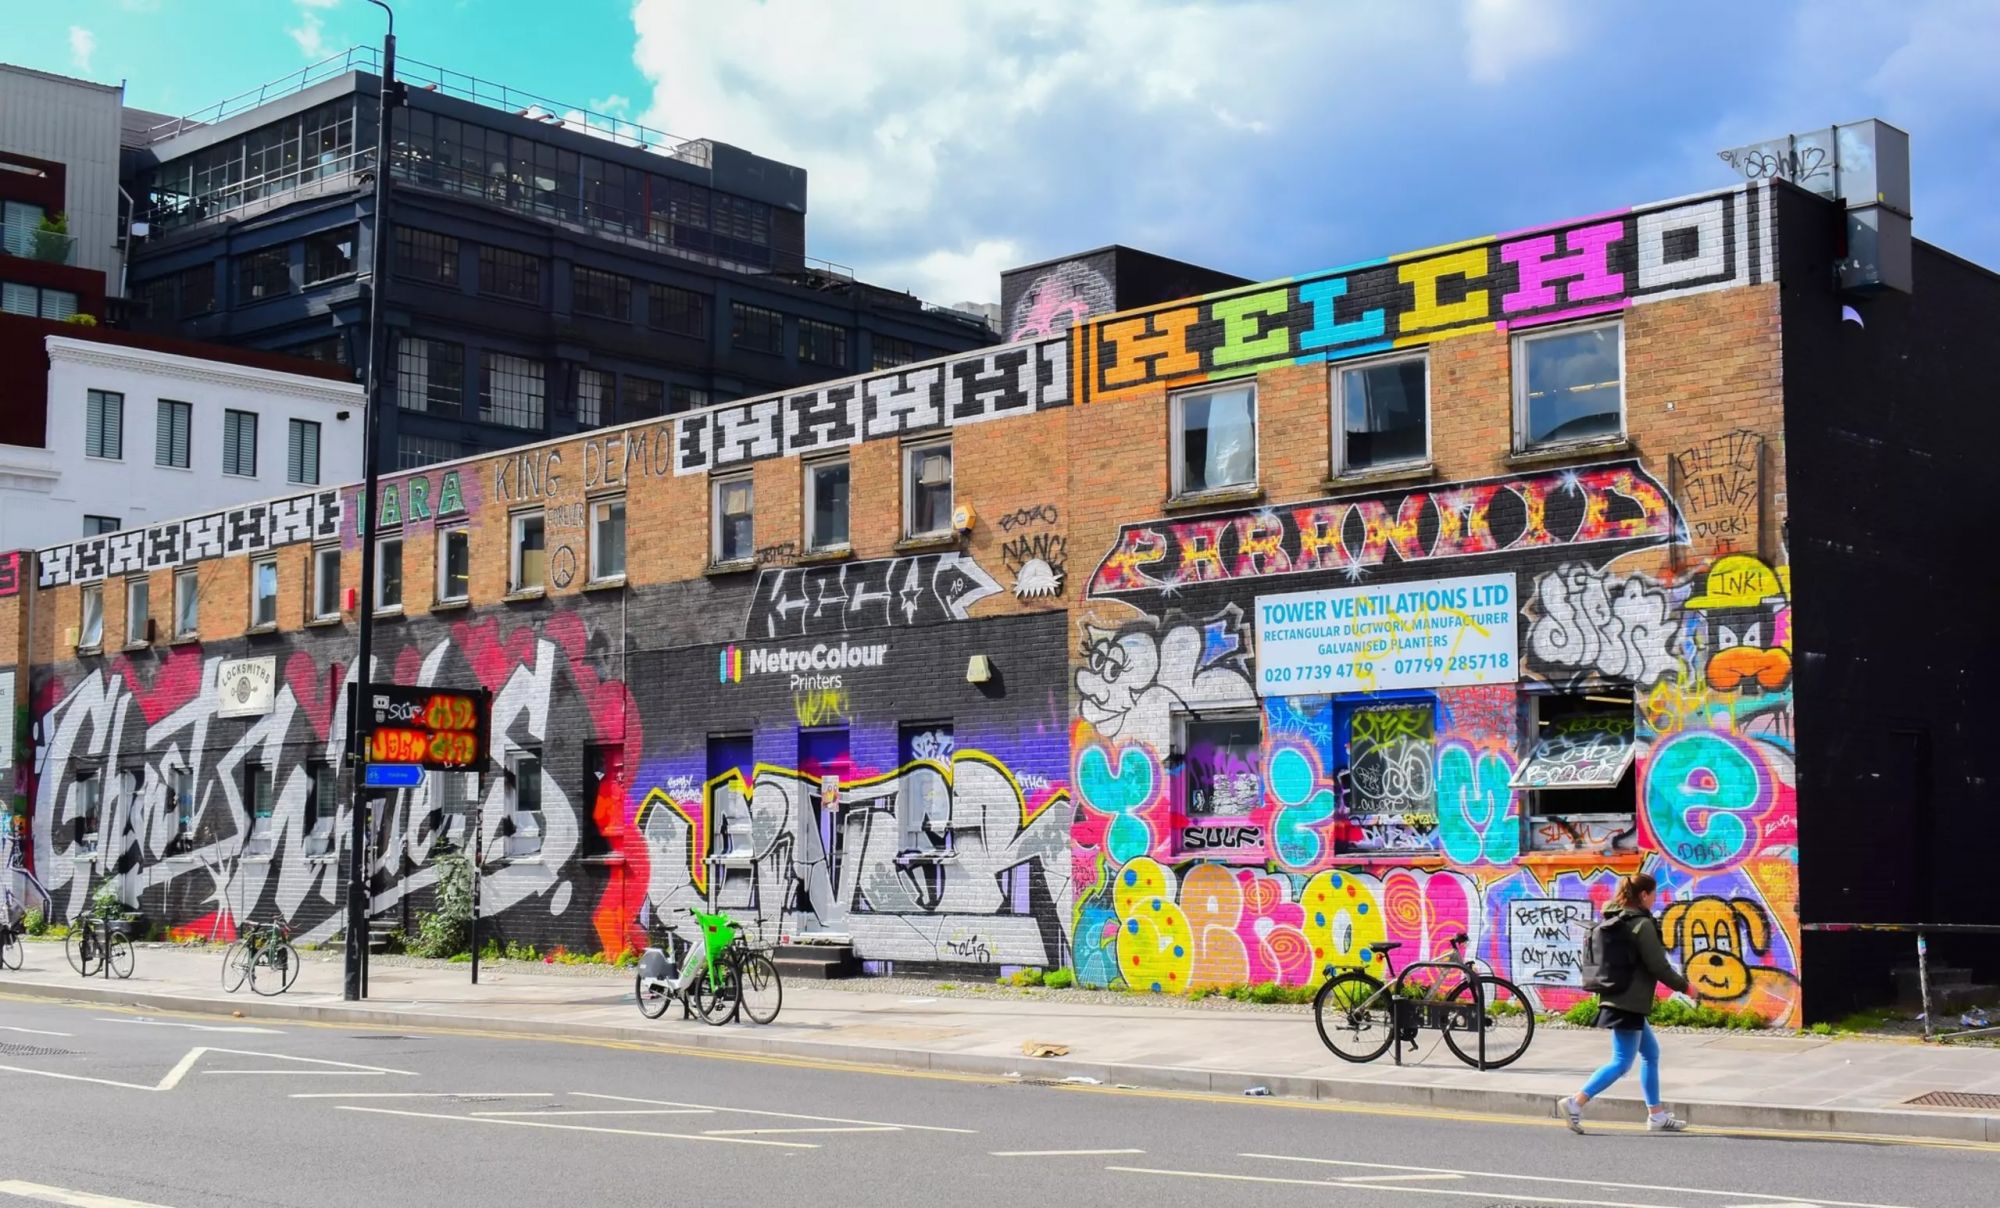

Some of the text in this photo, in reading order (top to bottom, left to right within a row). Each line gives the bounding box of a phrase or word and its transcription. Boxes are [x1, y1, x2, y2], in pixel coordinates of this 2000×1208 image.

[494, 427, 670, 504] KING DEMO
[1695, 513, 1748, 538] DUCK!
[1711, 570, 1764, 596] INK!
[1262, 584, 1509, 624] TOWER VENTILATIONS LTD
[1264, 612, 1509, 642] RECTANGULAR DUCTWORK MANUFACTURER
[750, 641, 888, 674] MetroColour
[1318, 634, 1448, 656] GALVANISED PLANTERS
[222, 663, 271, 687] LOCKSMITHS
[1265, 667, 1291, 682] 020
[1296, 664, 1332, 681] 7739
[1336, 661, 1373, 678] 4779
[1394, 657, 1444, 675] 07799
[1448, 652, 1509, 671] 285718
[790, 674, 842, 690] Printers
[1516, 905, 1578, 926] BETTER
[1534, 926, 1571, 941] MAN
[1521, 947, 1548, 969] OUT
